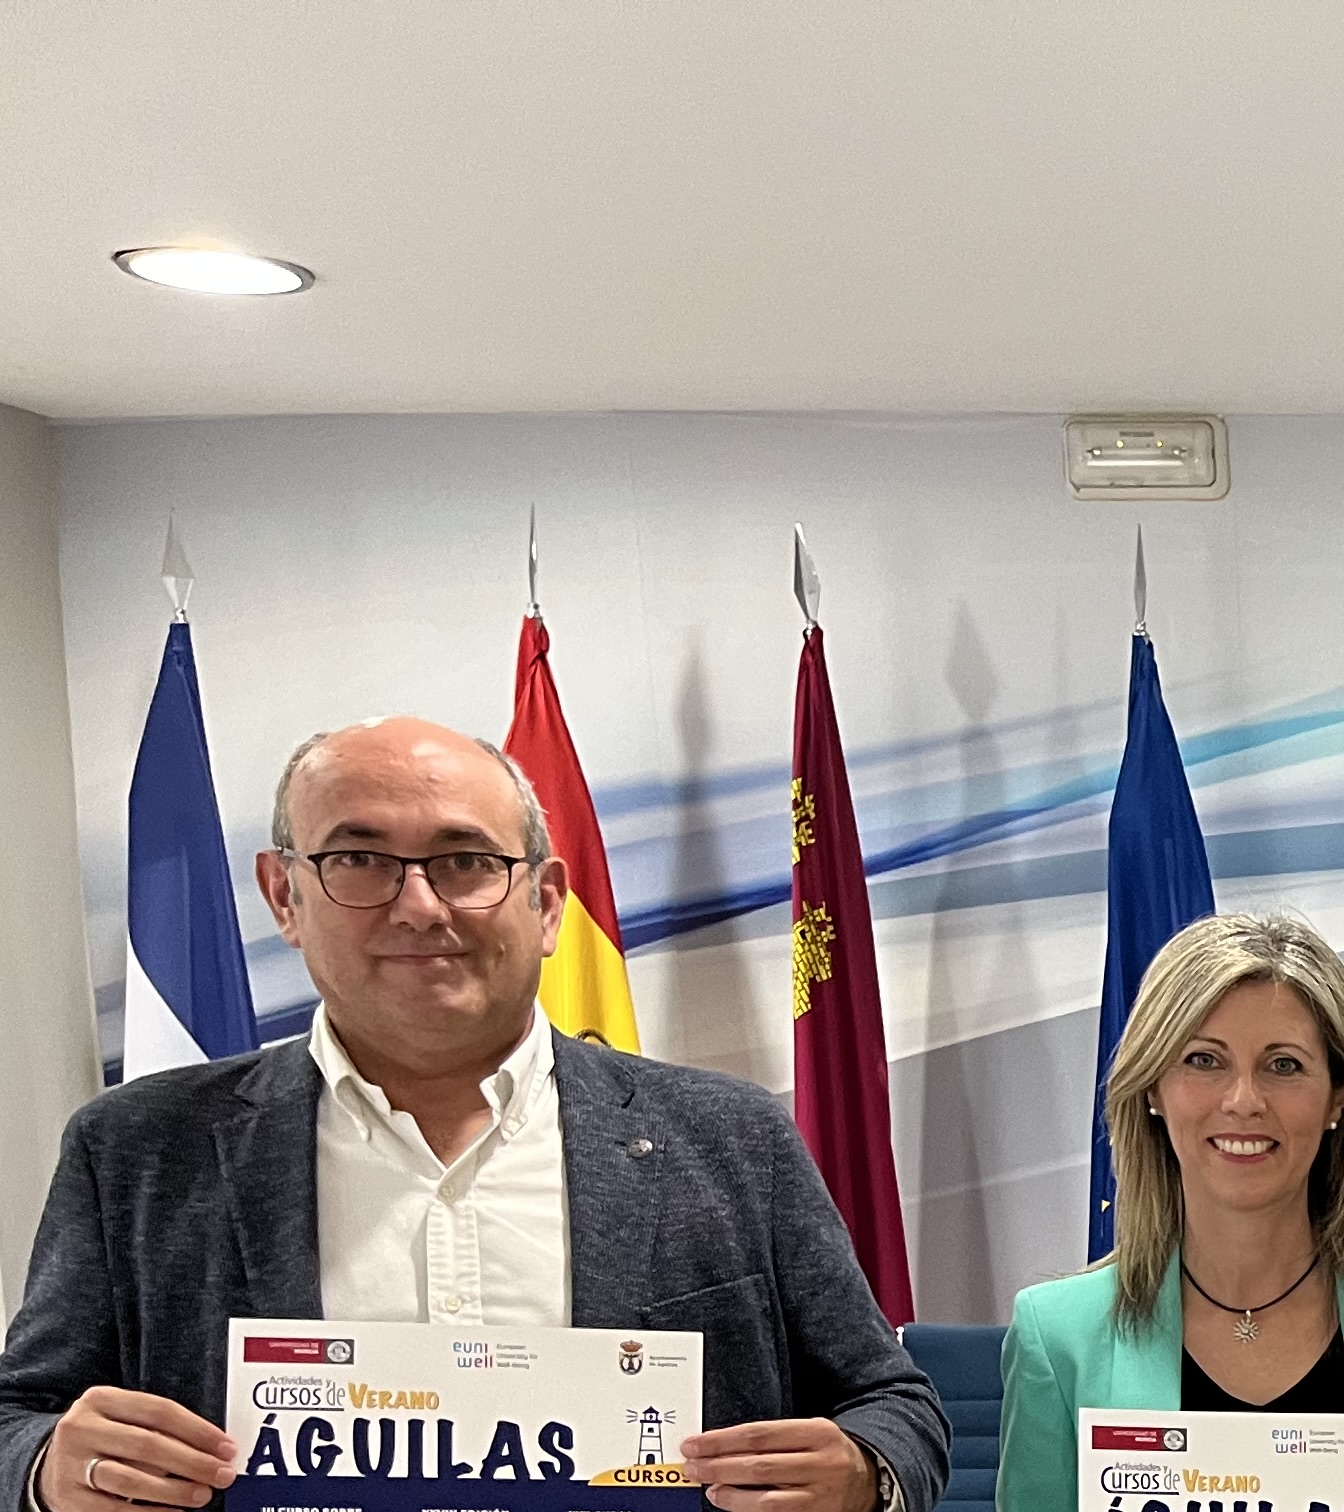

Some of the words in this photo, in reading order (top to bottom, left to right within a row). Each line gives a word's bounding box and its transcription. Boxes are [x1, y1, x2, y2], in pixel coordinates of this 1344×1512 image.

[456, 1355, 492, 1369] well
[245, 1412, 574, 1479] ÁGUILAS
[1275, 1441, 1306, 1453] well
